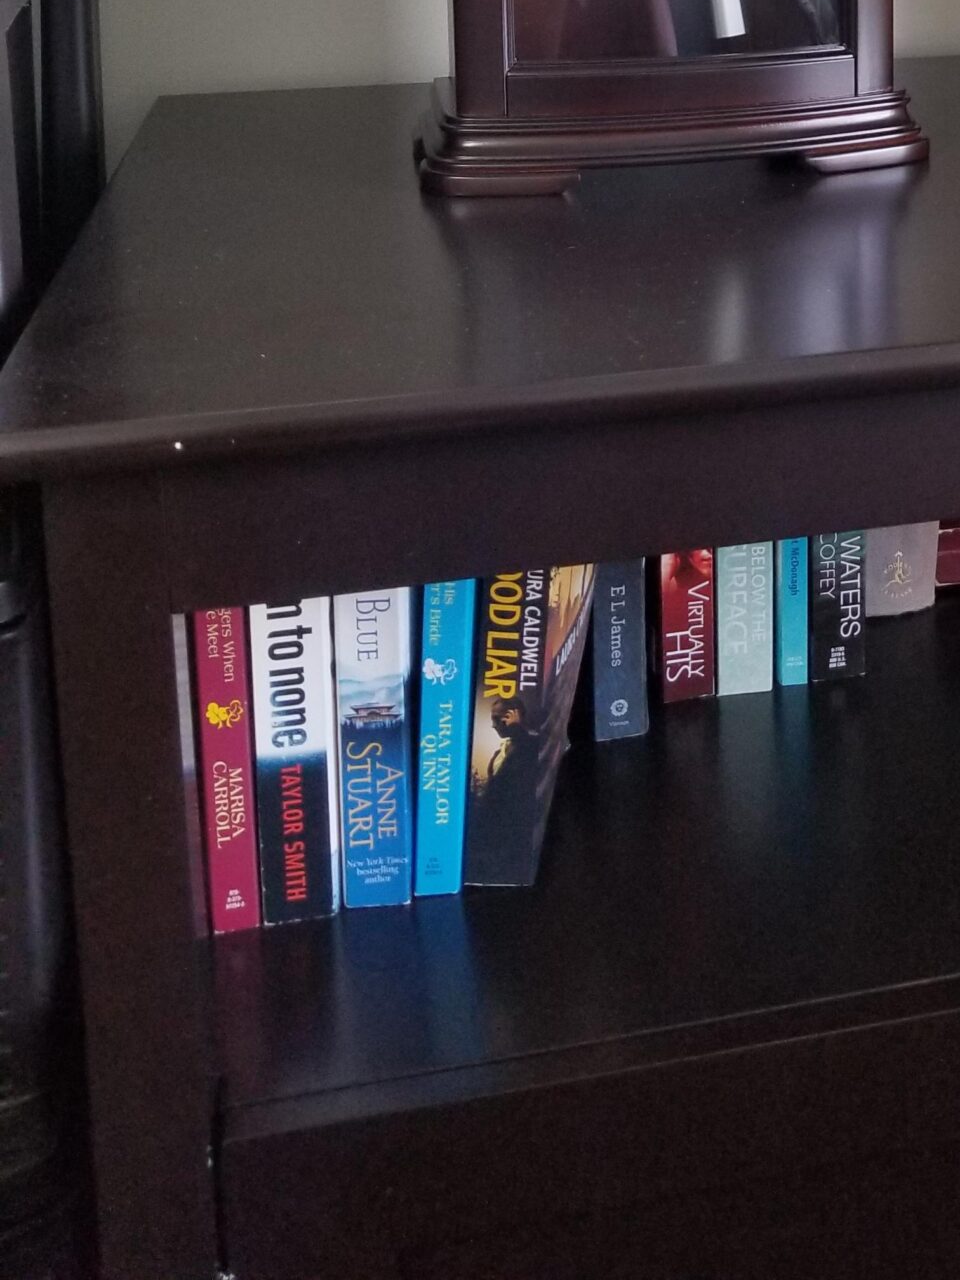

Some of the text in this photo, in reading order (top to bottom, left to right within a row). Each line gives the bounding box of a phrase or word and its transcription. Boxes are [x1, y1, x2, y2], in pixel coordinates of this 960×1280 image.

[751, 546, 766, 642] BELOW THE
[788, 548, 800, 596] McDonagh
[840, 536, 861, 638] WATERS
[207, 624, 220, 659] Meet
[223, 641, 236, 682] When
[267, 625, 312, 661] to
[355, 597, 391, 662] BLUE
[429, 609, 441, 646] Bride
[519, 606, 541, 691] CALDWELL
[610, 585, 626, 667] E L James
[666, 631, 692, 682] HIS
[688, 580, 710, 678] VIRTUALLY
[483, 630, 520, 699] LIAR
[269, 666, 307, 748] none
[346, 741, 383, 851] STUART
[420, 734, 437, 791] QUINN
[435, 699, 453, 825] TARA TAYLOR
[212, 761, 231, 849] CARROLL
[229, 767, 246, 838] MARISA
[281, 764, 306, 901] TAYLOR SMITH
[376, 761, 405, 839] ANNE
[347, 859, 364, 868] New
[366, 856, 384, 866] York
[364, 875, 391, 885] author
